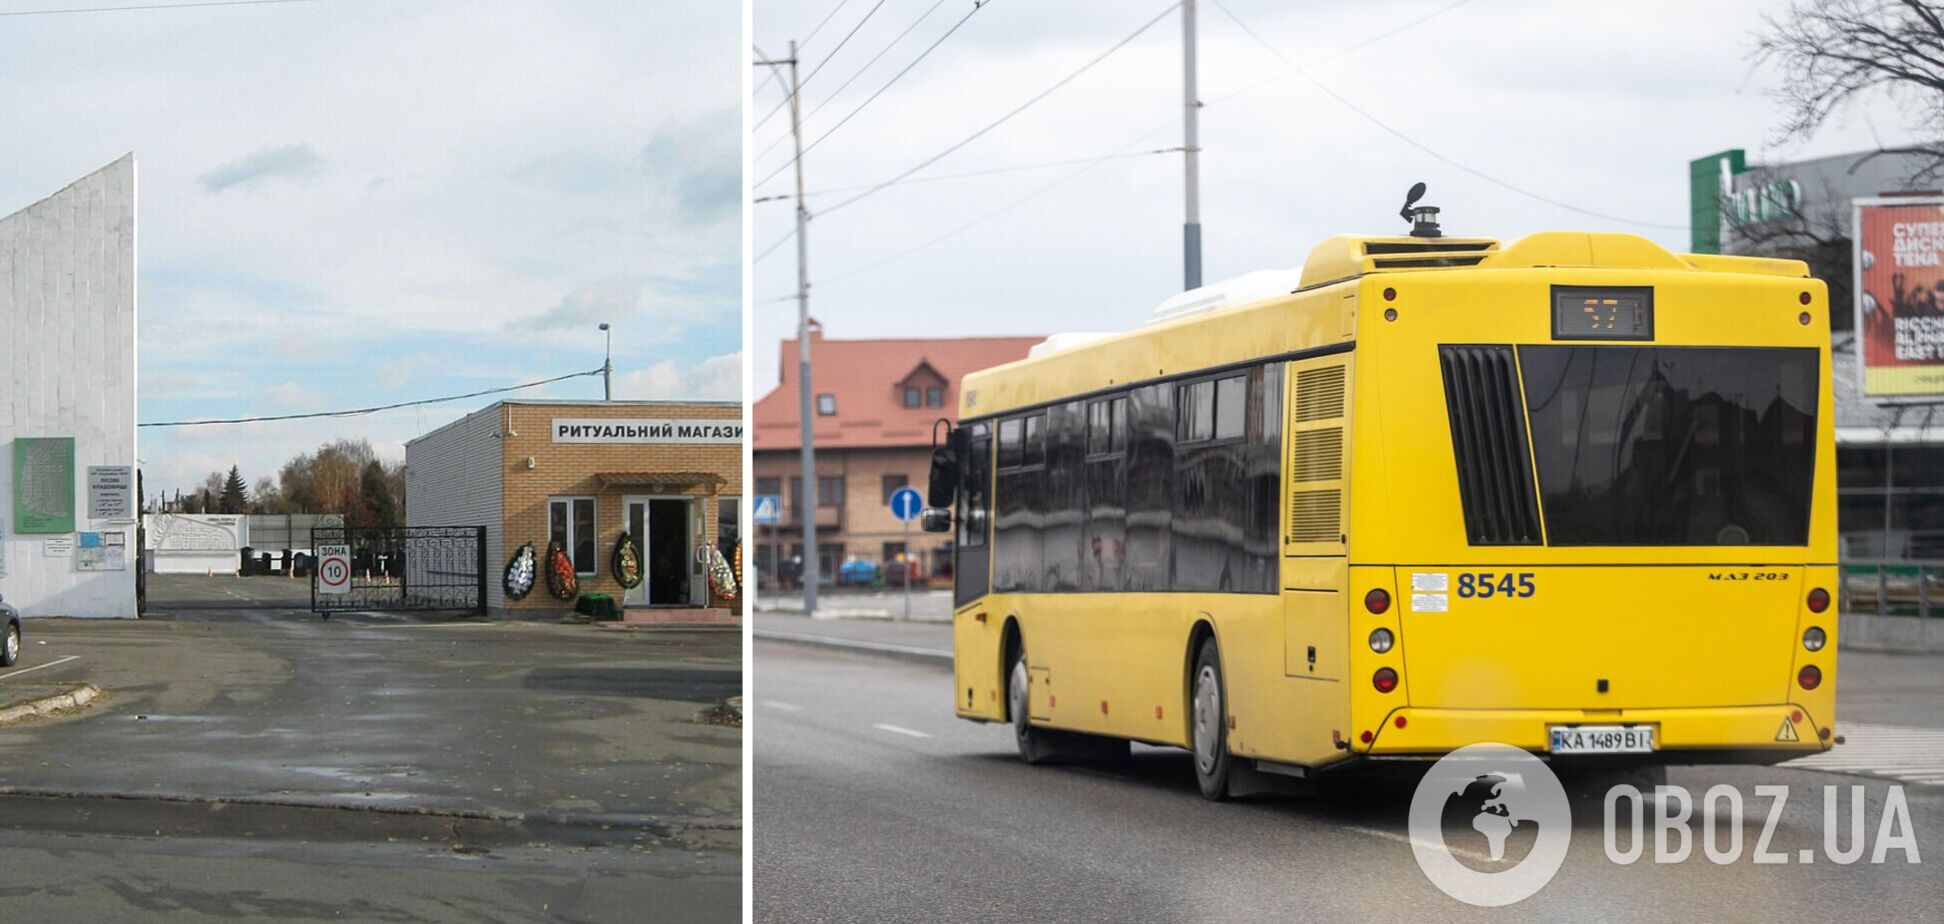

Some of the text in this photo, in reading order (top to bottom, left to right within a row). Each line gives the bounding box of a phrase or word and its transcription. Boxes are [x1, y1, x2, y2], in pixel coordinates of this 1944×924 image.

[558, 423, 673, 438] РИТУАЛЬНИЙ
[321, 547, 347, 556] ЗОНА
[328, 566, 342, 578] 10
[1753, 572, 1789, 581] 203
[1457, 572, 1536, 598] 8545
[1589, 732, 1622, 749] 1489
